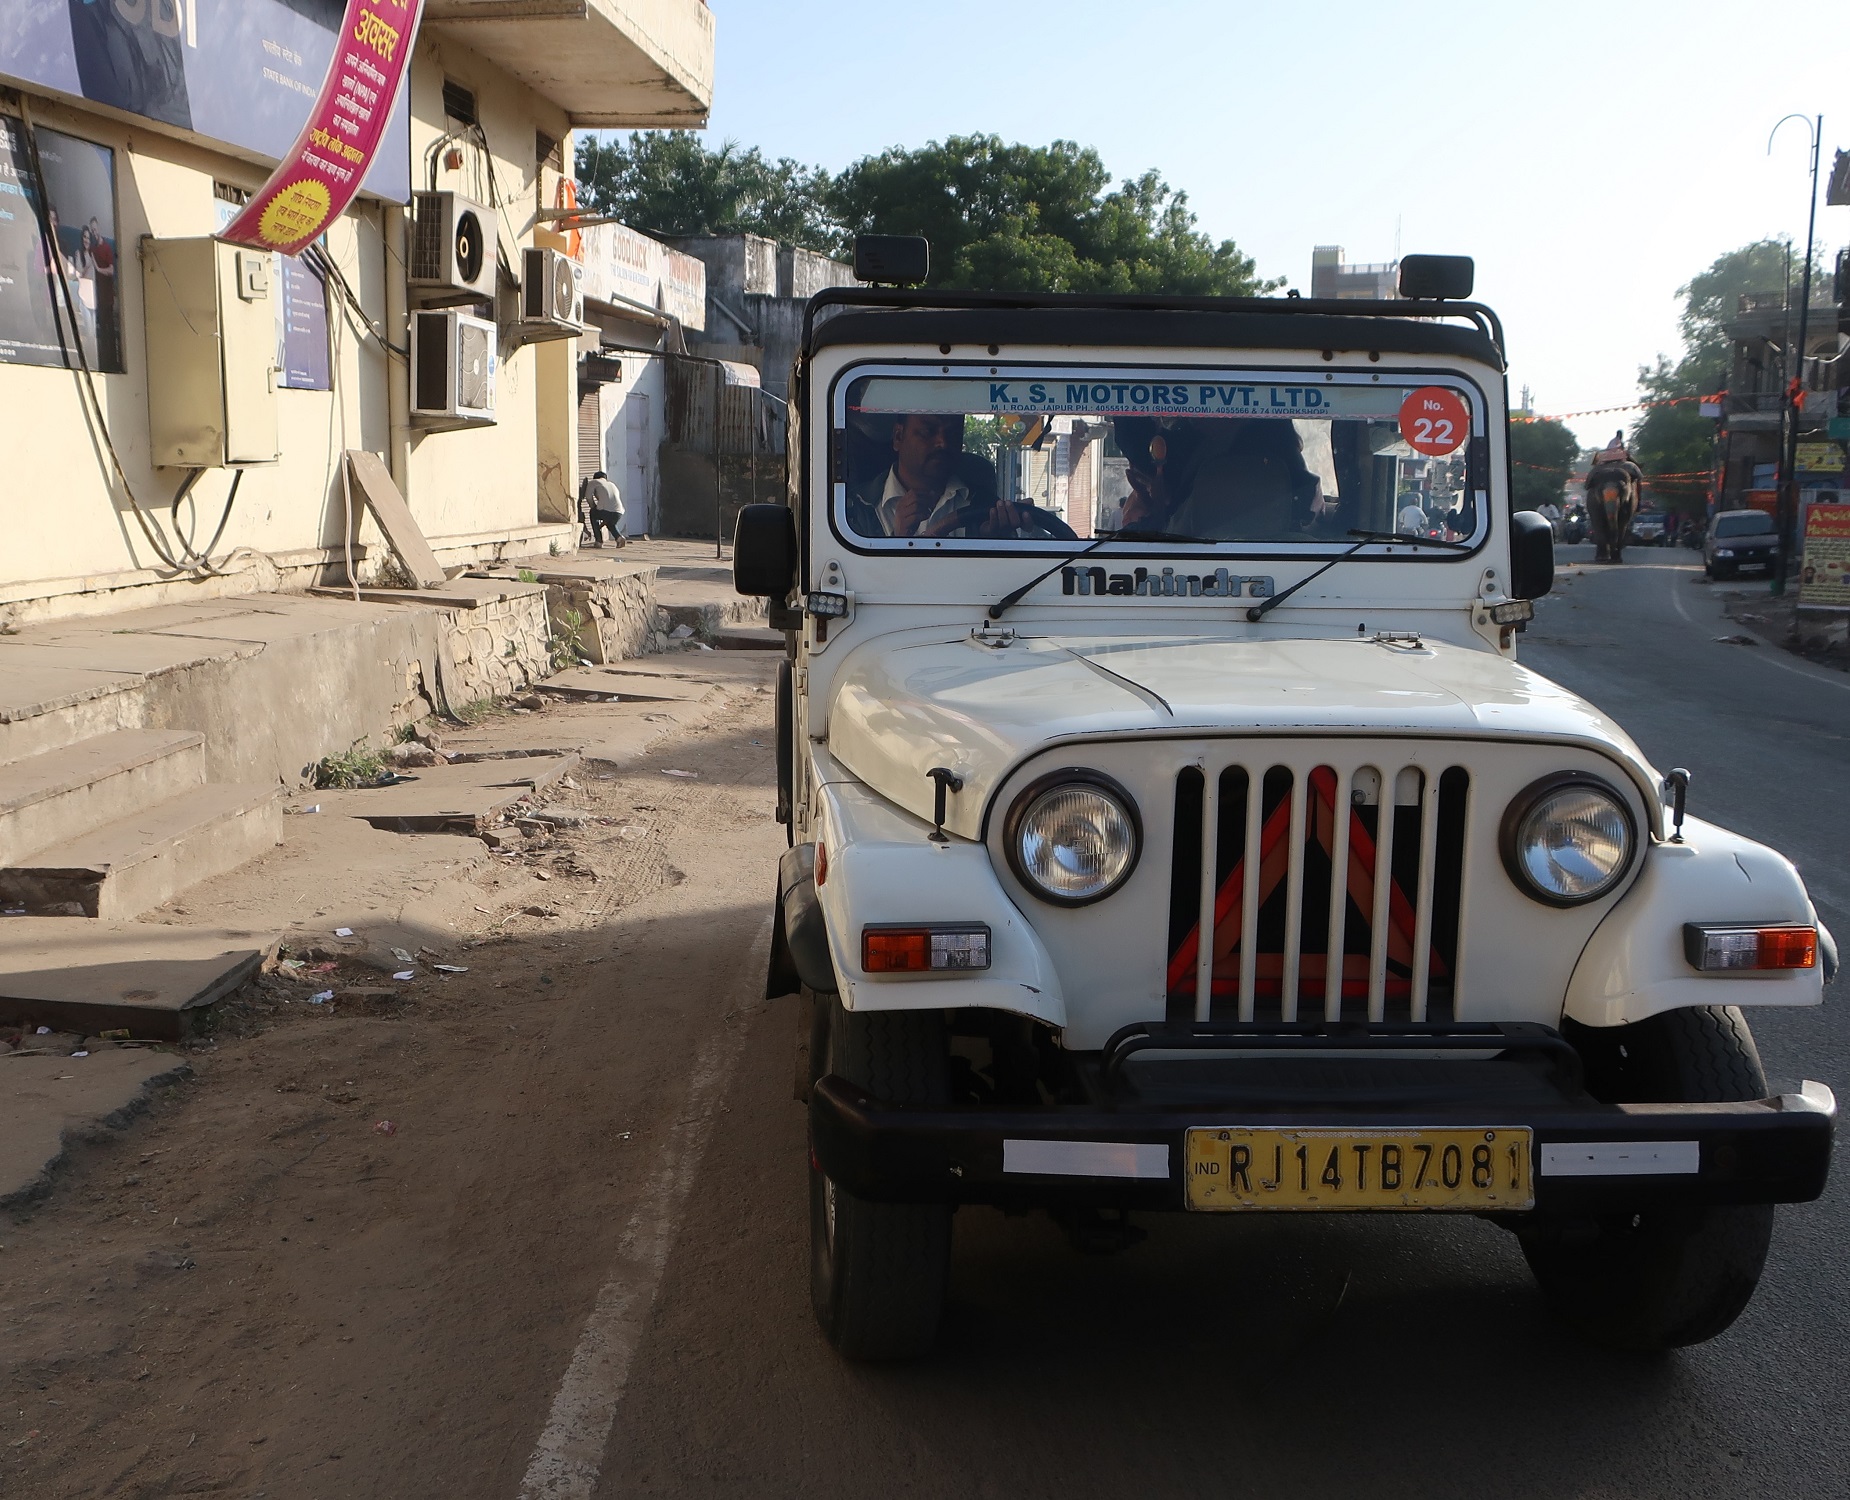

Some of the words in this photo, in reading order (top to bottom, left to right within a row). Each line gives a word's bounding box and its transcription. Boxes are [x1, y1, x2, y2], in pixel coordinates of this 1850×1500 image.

[354, 8, 399, 62] अवसर
[262, 66, 280, 83] STATE
[279, 74, 295, 89] BANK
[294, 80, 302, 92] OF
[302, 84, 316, 98] INDIA
[612, 232, 630, 262] GOOD
[631, 239, 648, 270] LUCK
[989, 384, 1018, 403] K.
[1029, 384, 1055, 403] S.
[1066, 385, 1189, 405] MOTORS
[1200, 386, 1259, 406] PVT.
[1270, 388, 1330, 408] LTD.
[1423, 400, 1444, 411] No.
[1414, 418, 1454, 444] 22
[1061, 566, 1275, 597] Mahindra
[1195, 1162, 1220, 1175] IND
[1228, 1143, 1521, 1191] RJ14TB7081
